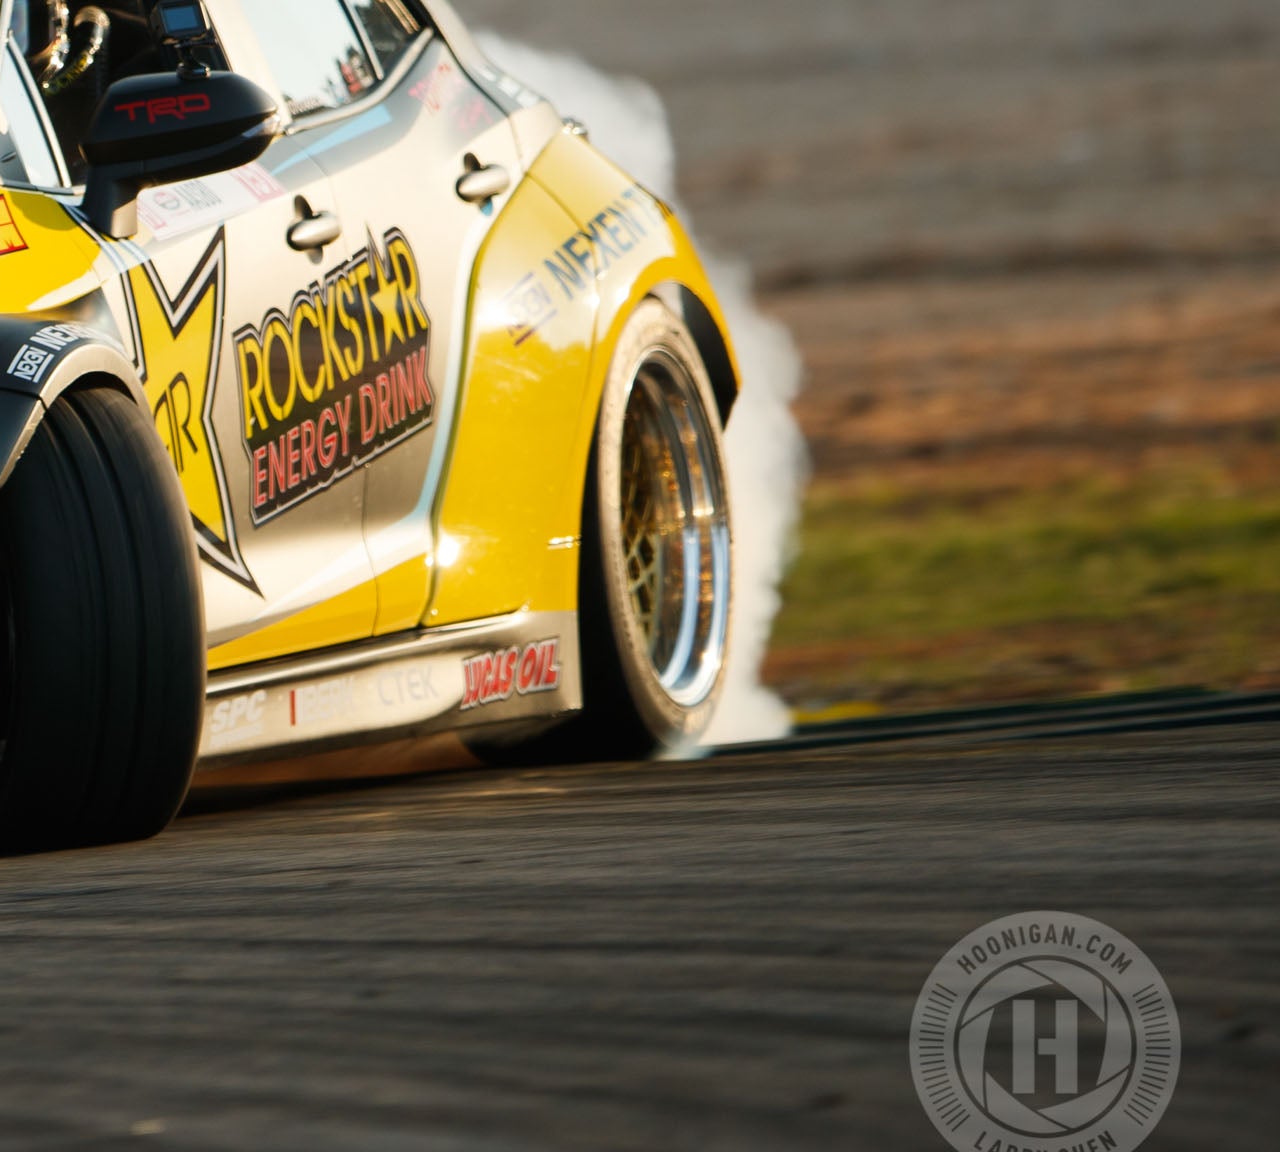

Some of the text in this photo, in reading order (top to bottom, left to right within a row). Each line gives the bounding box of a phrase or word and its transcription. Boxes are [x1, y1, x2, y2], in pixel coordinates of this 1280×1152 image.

[113, 92, 211, 124] TRD
[252, 344, 432, 509] ENERGY DRINK
[460, 641, 560, 709] LUCAS OIL
